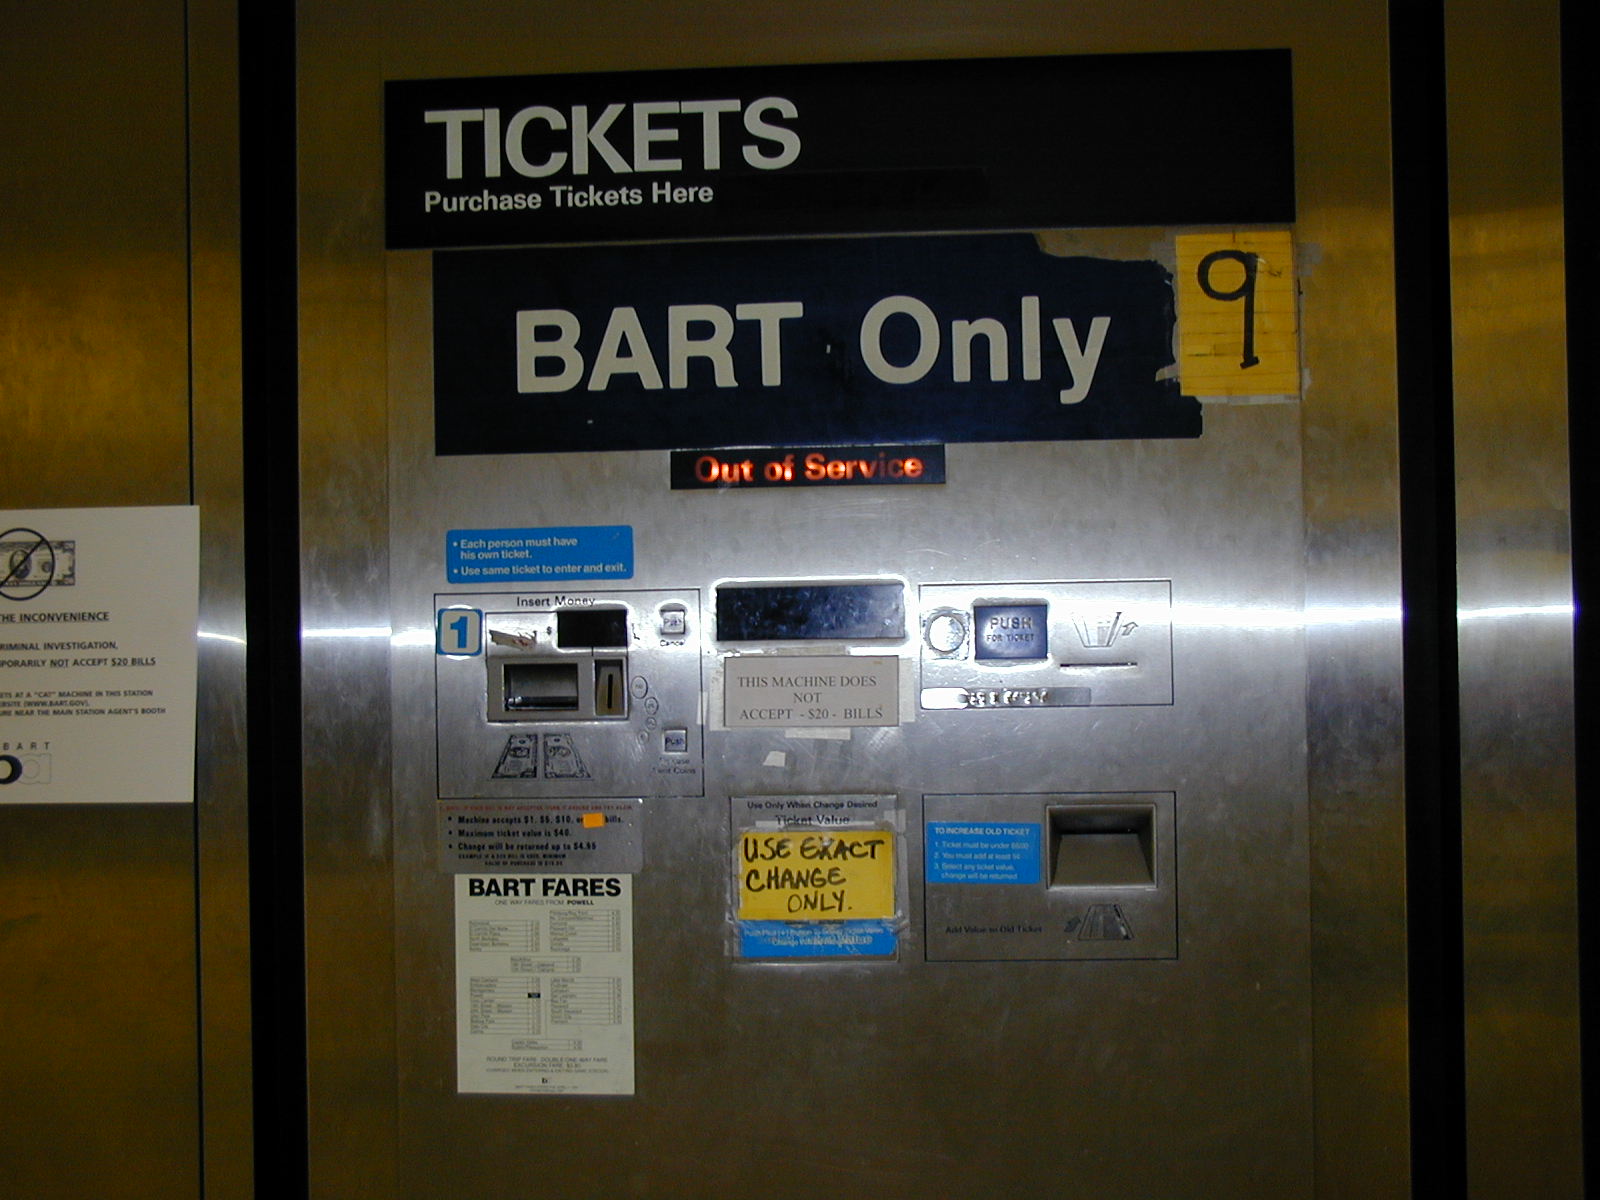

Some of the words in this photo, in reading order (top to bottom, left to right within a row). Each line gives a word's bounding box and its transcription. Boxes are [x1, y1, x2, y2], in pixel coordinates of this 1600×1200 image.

[424, 97, 801, 179] TICKETS
[424, 189, 541, 212] Purchase
[549, 184, 643, 208] Tickets
[652, 182, 714, 203] Here
[1197, 249, 1260, 370] 9
[516, 301, 803, 393] BART
[859, 295, 1111, 404] Only
[695, 455, 754, 483] Out
[764, 454, 796, 481] of
[804, 452, 924, 480] Service
[460, 539, 486, 549] Each
[487, 539, 523, 551] person
[525, 538, 551, 547] must
[553, 536, 578, 546] have
[460, 550, 476, 559] his
[478, 551, 499, 559] own
[501, 549, 533, 559] ticket.
[461, 566, 481, 575] Use
[482, 566, 510, 575] same
[512, 564, 541, 574] ticket
[542, 565, 552, 573] to
[554, 564, 582, 573] enter
[583, 563, 603, 572] and
[605, 563, 627, 572] exit.
[517, 596, 550, 607] Insert
[554, 595, 596, 607] Money
[20, 611, 110, 622] INCONVENIENCE
[990, 616, 1032, 630] PUSH
[450, 616, 469, 649] 1
[986, 634, 1003, 642] FOR
[1006, 633, 1035, 642] TICKET
[0, 659, 46, 668] PORARILY
[50, 659, 69, 668] NOT
[72, 658, 108, 667] ACCEPT
[111, 657, 129, 667] $20
[131, 656, 157, 667] BILLS
[737, 676, 768, 688] THIS
[771, 676, 836, 688] MACHINE
[840, 675, 877, 687] DOES
[58, 690, 93, 698] MACHINE
[123, 689, 154, 697] STATION
[793, 692, 823, 704] NOT
[53, 708, 74, 716] MAIN
[75, 708, 106, 716] STATION
[141, 707, 167, 715] BOOTH
[739, 709, 793, 720] ACCEPT
[808, 708, 829, 720] $20
[844, 708, 884, 720] BILLS
[747, 801, 763, 809] Use
[765, 801, 784, 811] Only
[786, 801, 811, 809] When
[813, 800, 844, 810] Change
[847, 799, 878, 808] Desired
[458, 815, 489, 824] Machine
[775, 815, 812, 826] Ticket
[815, 814, 851, 826] Value
[458, 829, 494, 838] Maximum
[497, 829, 520, 838] ticket
[522, 829, 542, 838] value
[544, 829, 551, 837] is
[935, 827, 945, 835] TO
[946, 827, 984, 835] INCREASE
[985, 827, 1002, 836] OLD
[1003, 827, 1030, 836] TICKET
[458, 842, 486, 853] Change
[488, 842, 503, 851] will
[505, 842, 514, 851] be
[516, 842, 549, 851] returned
[551, 843, 560, 852] up
[563, 842, 571, 851] to
[743, 837, 792, 863] USE
[800, 835, 885, 861] EXACT
[745, 865, 847, 892] CHANGE
[468, 877, 536, 897] BART
[542, 877, 622, 897] FARES
[787, 890, 853, 913] ONLY.
